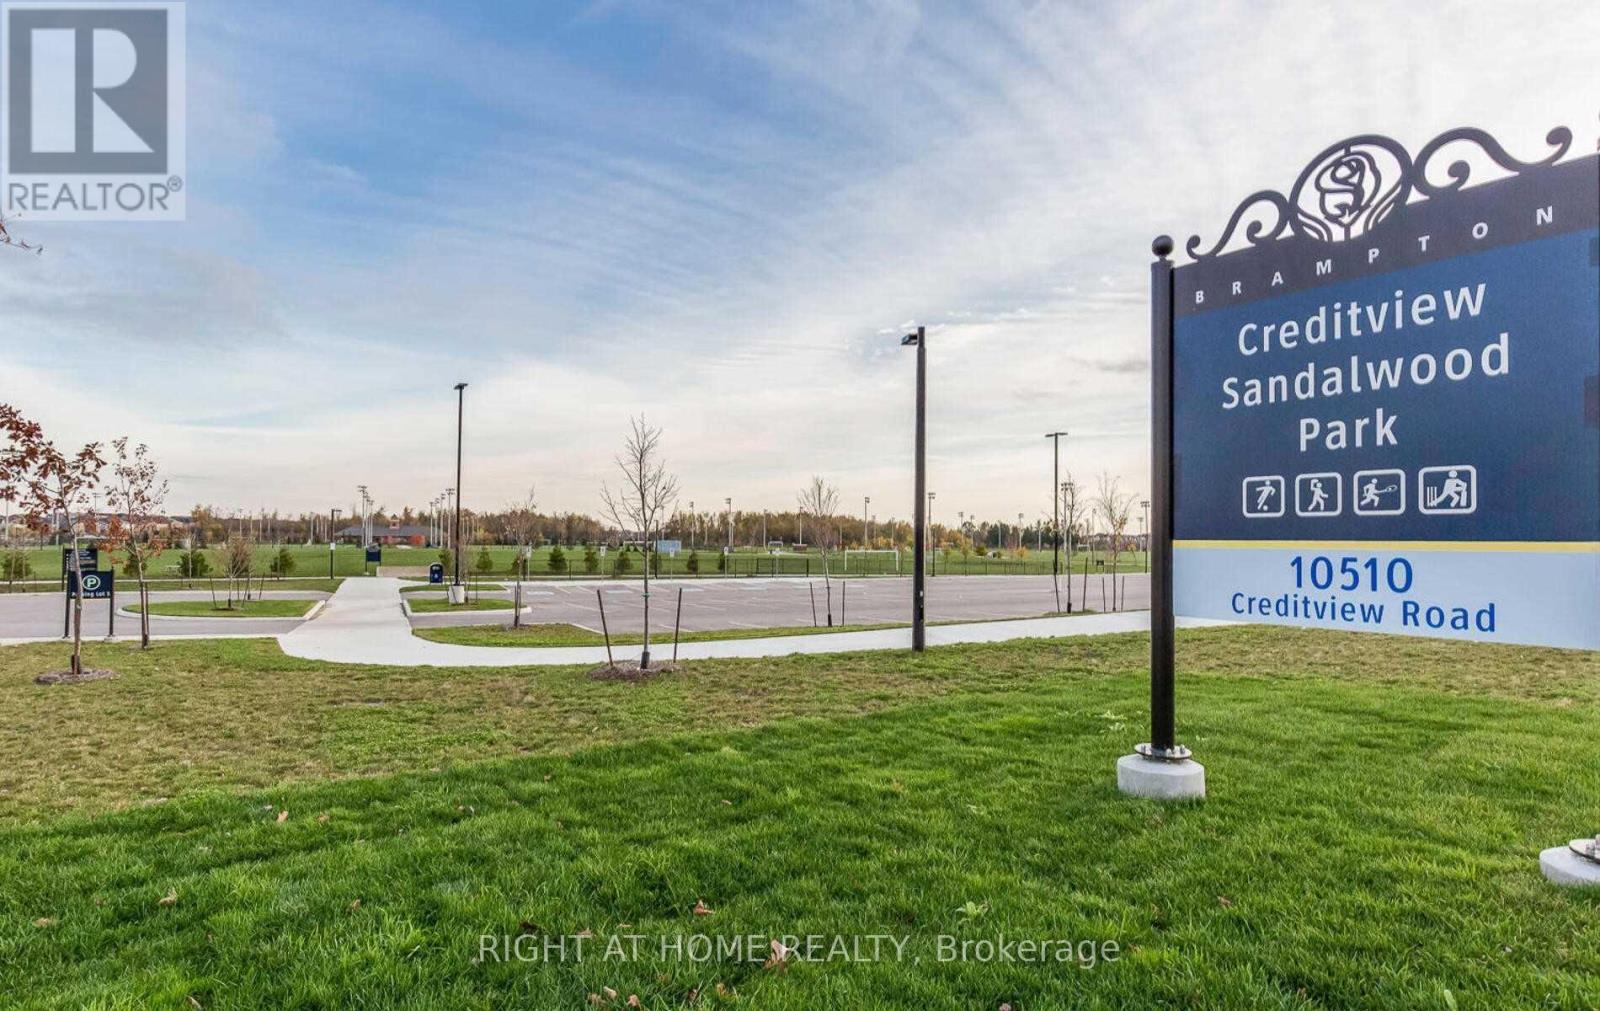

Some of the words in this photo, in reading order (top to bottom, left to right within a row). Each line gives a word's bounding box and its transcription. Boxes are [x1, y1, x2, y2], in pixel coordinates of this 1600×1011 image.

[1195, 205, 1554, 305] BRAMPTON
[1237, 282, 1487, 356] Creditview
[1221, 332, 1510, 409] Sandalwood
[1299, 408, 1399, 452] Park
[87, 577, 97, 588] P
[1290, 555, 1414, 593] 10510
[1231, 592, 1384, 624] Creditview
[1402, 600, 1496, 632] Road
